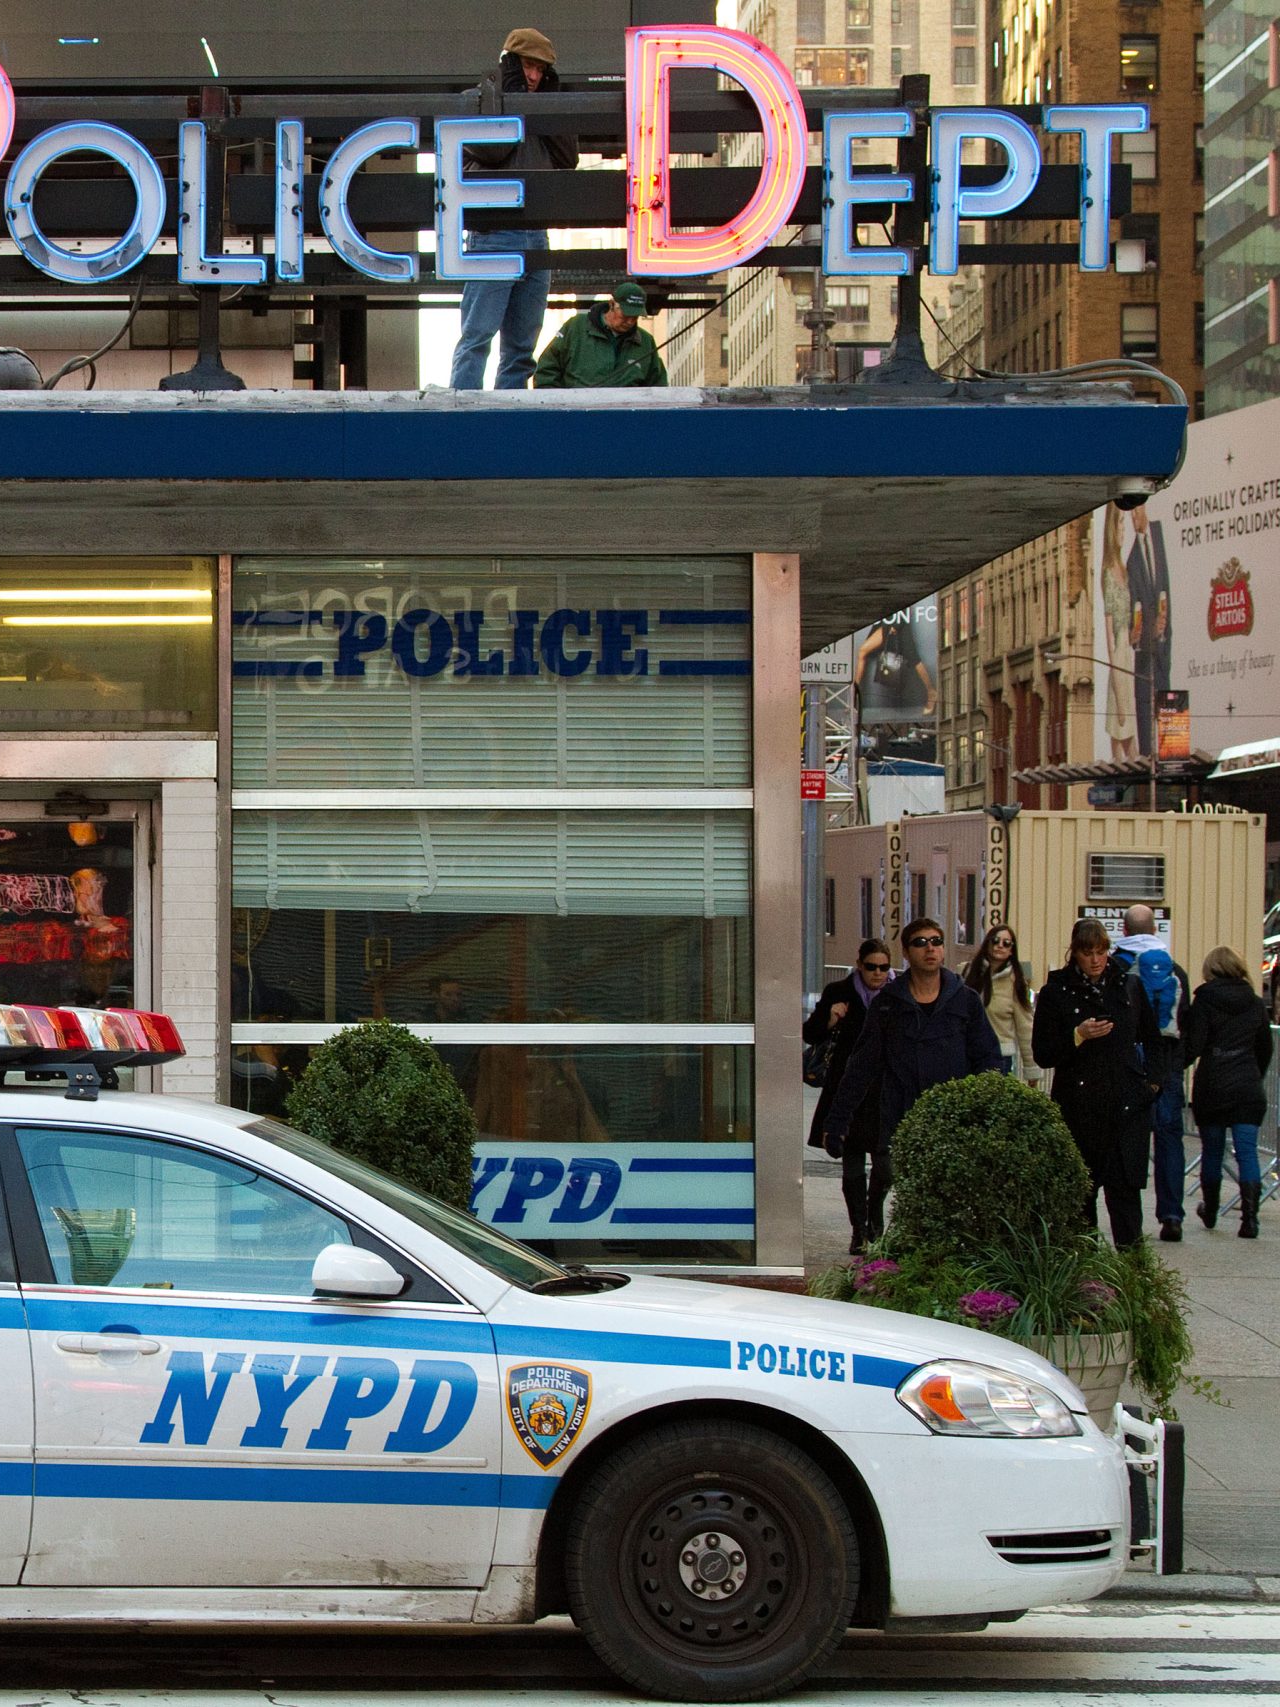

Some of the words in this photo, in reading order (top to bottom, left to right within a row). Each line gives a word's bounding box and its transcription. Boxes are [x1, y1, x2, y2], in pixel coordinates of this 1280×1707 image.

[625, 24, 1150, 277] DEPT
[1173, 489, 1236, 522] ORIGINALLY
[1181, 525, 1201, 548] FOR
[1205, 520, 1224, 542] THE
[1216, 590, 1245, 609] STELLA
[1215, 607, 1246, 627] ARTOIS
[328, 608, 650, 678] POLICE
[800, 662, 821, 674] URN
[825, 663, 849, 675] LEFT
[1187, 658, 1201, 678] She
[468, 1157, 622, 1224] YPD
[527, 1367, 573, 1382] POLICE
[737, 1341, 845, 1382] POLICE
[139, 1350, 478, 1453] NYPD
[511, 1377, 587, 1399] DEPARTMENT
[511, 1406, 527, 1432] CITY
[523, 1435, 537, 1449] OF
[551, 1433, 572, 1456] NEW
[568, 1404, 587, 1432] YORK
